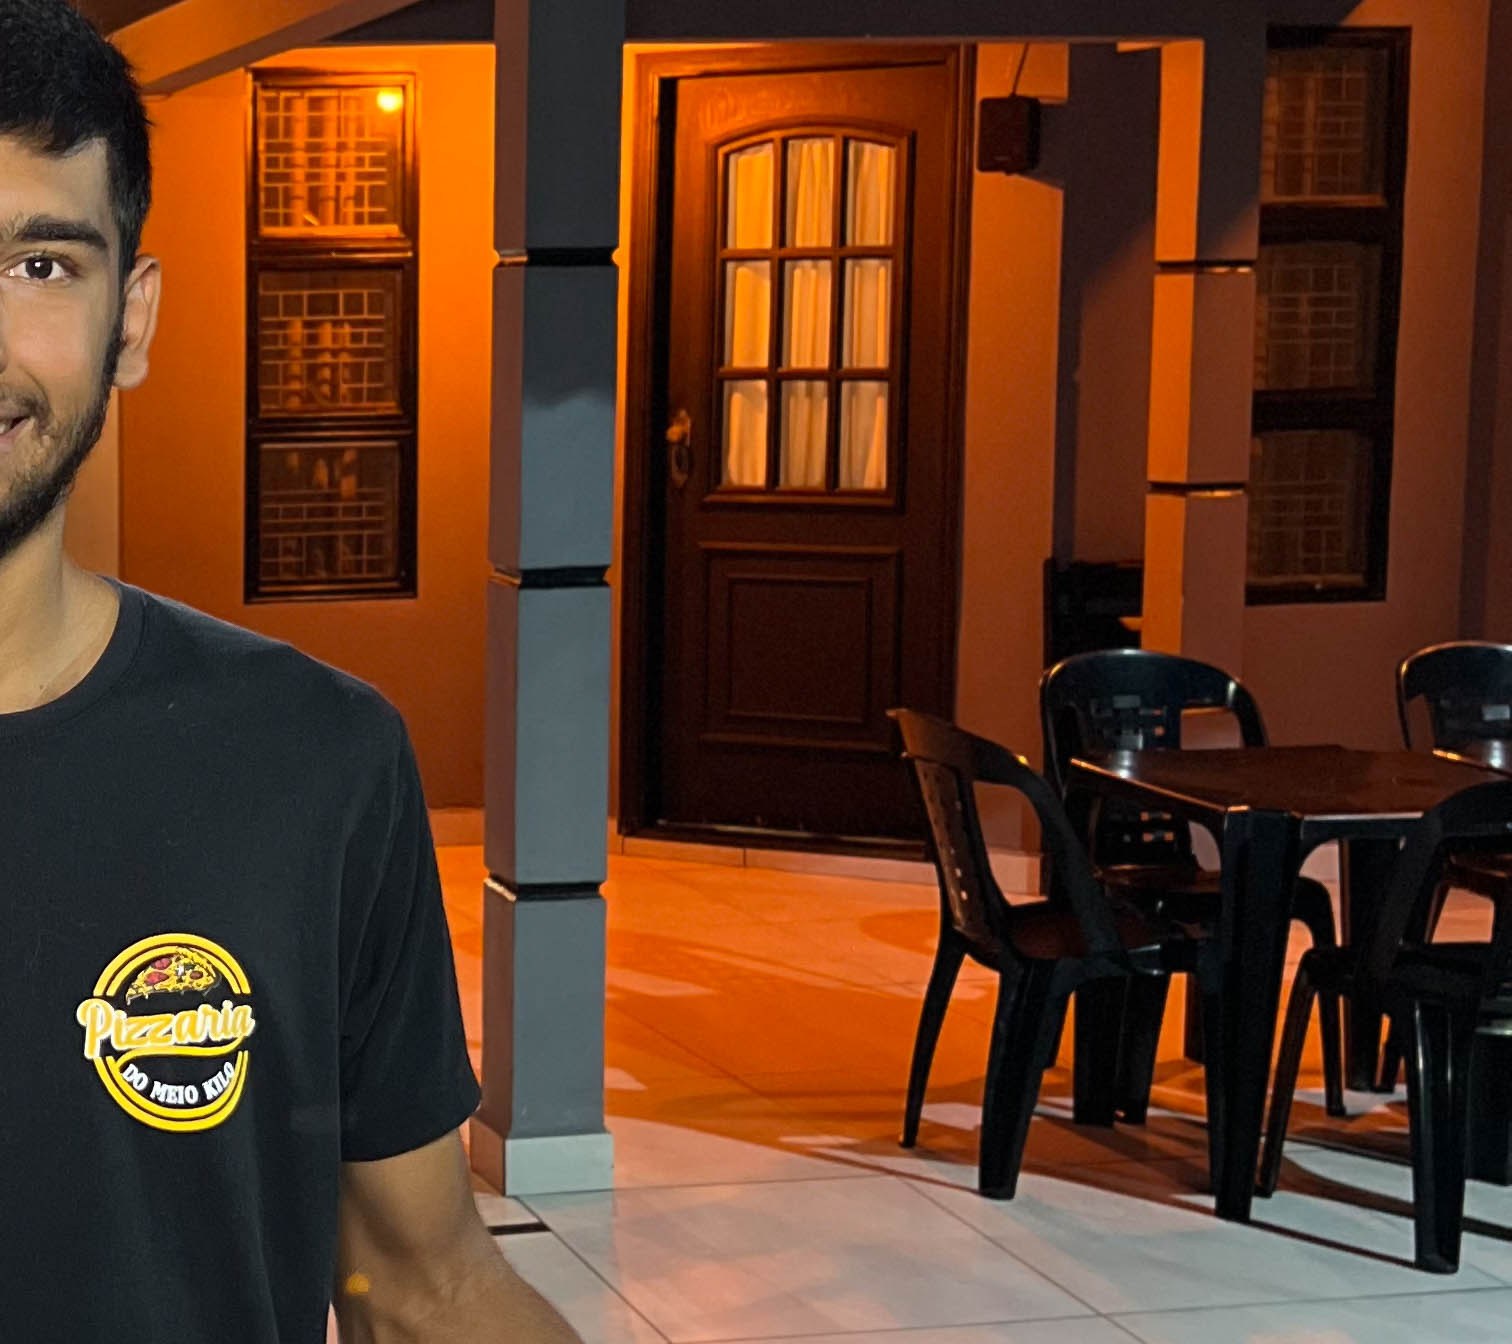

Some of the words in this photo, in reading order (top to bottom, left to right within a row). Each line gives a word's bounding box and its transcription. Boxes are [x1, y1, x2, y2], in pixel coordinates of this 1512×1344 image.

[77, 998, 255, 1059] Pizzaria
[121, 1063, 148, 1091] DO
[150, 1081, 199, 1104] MEIO
[202, 1062, 235, 1100] KILO
